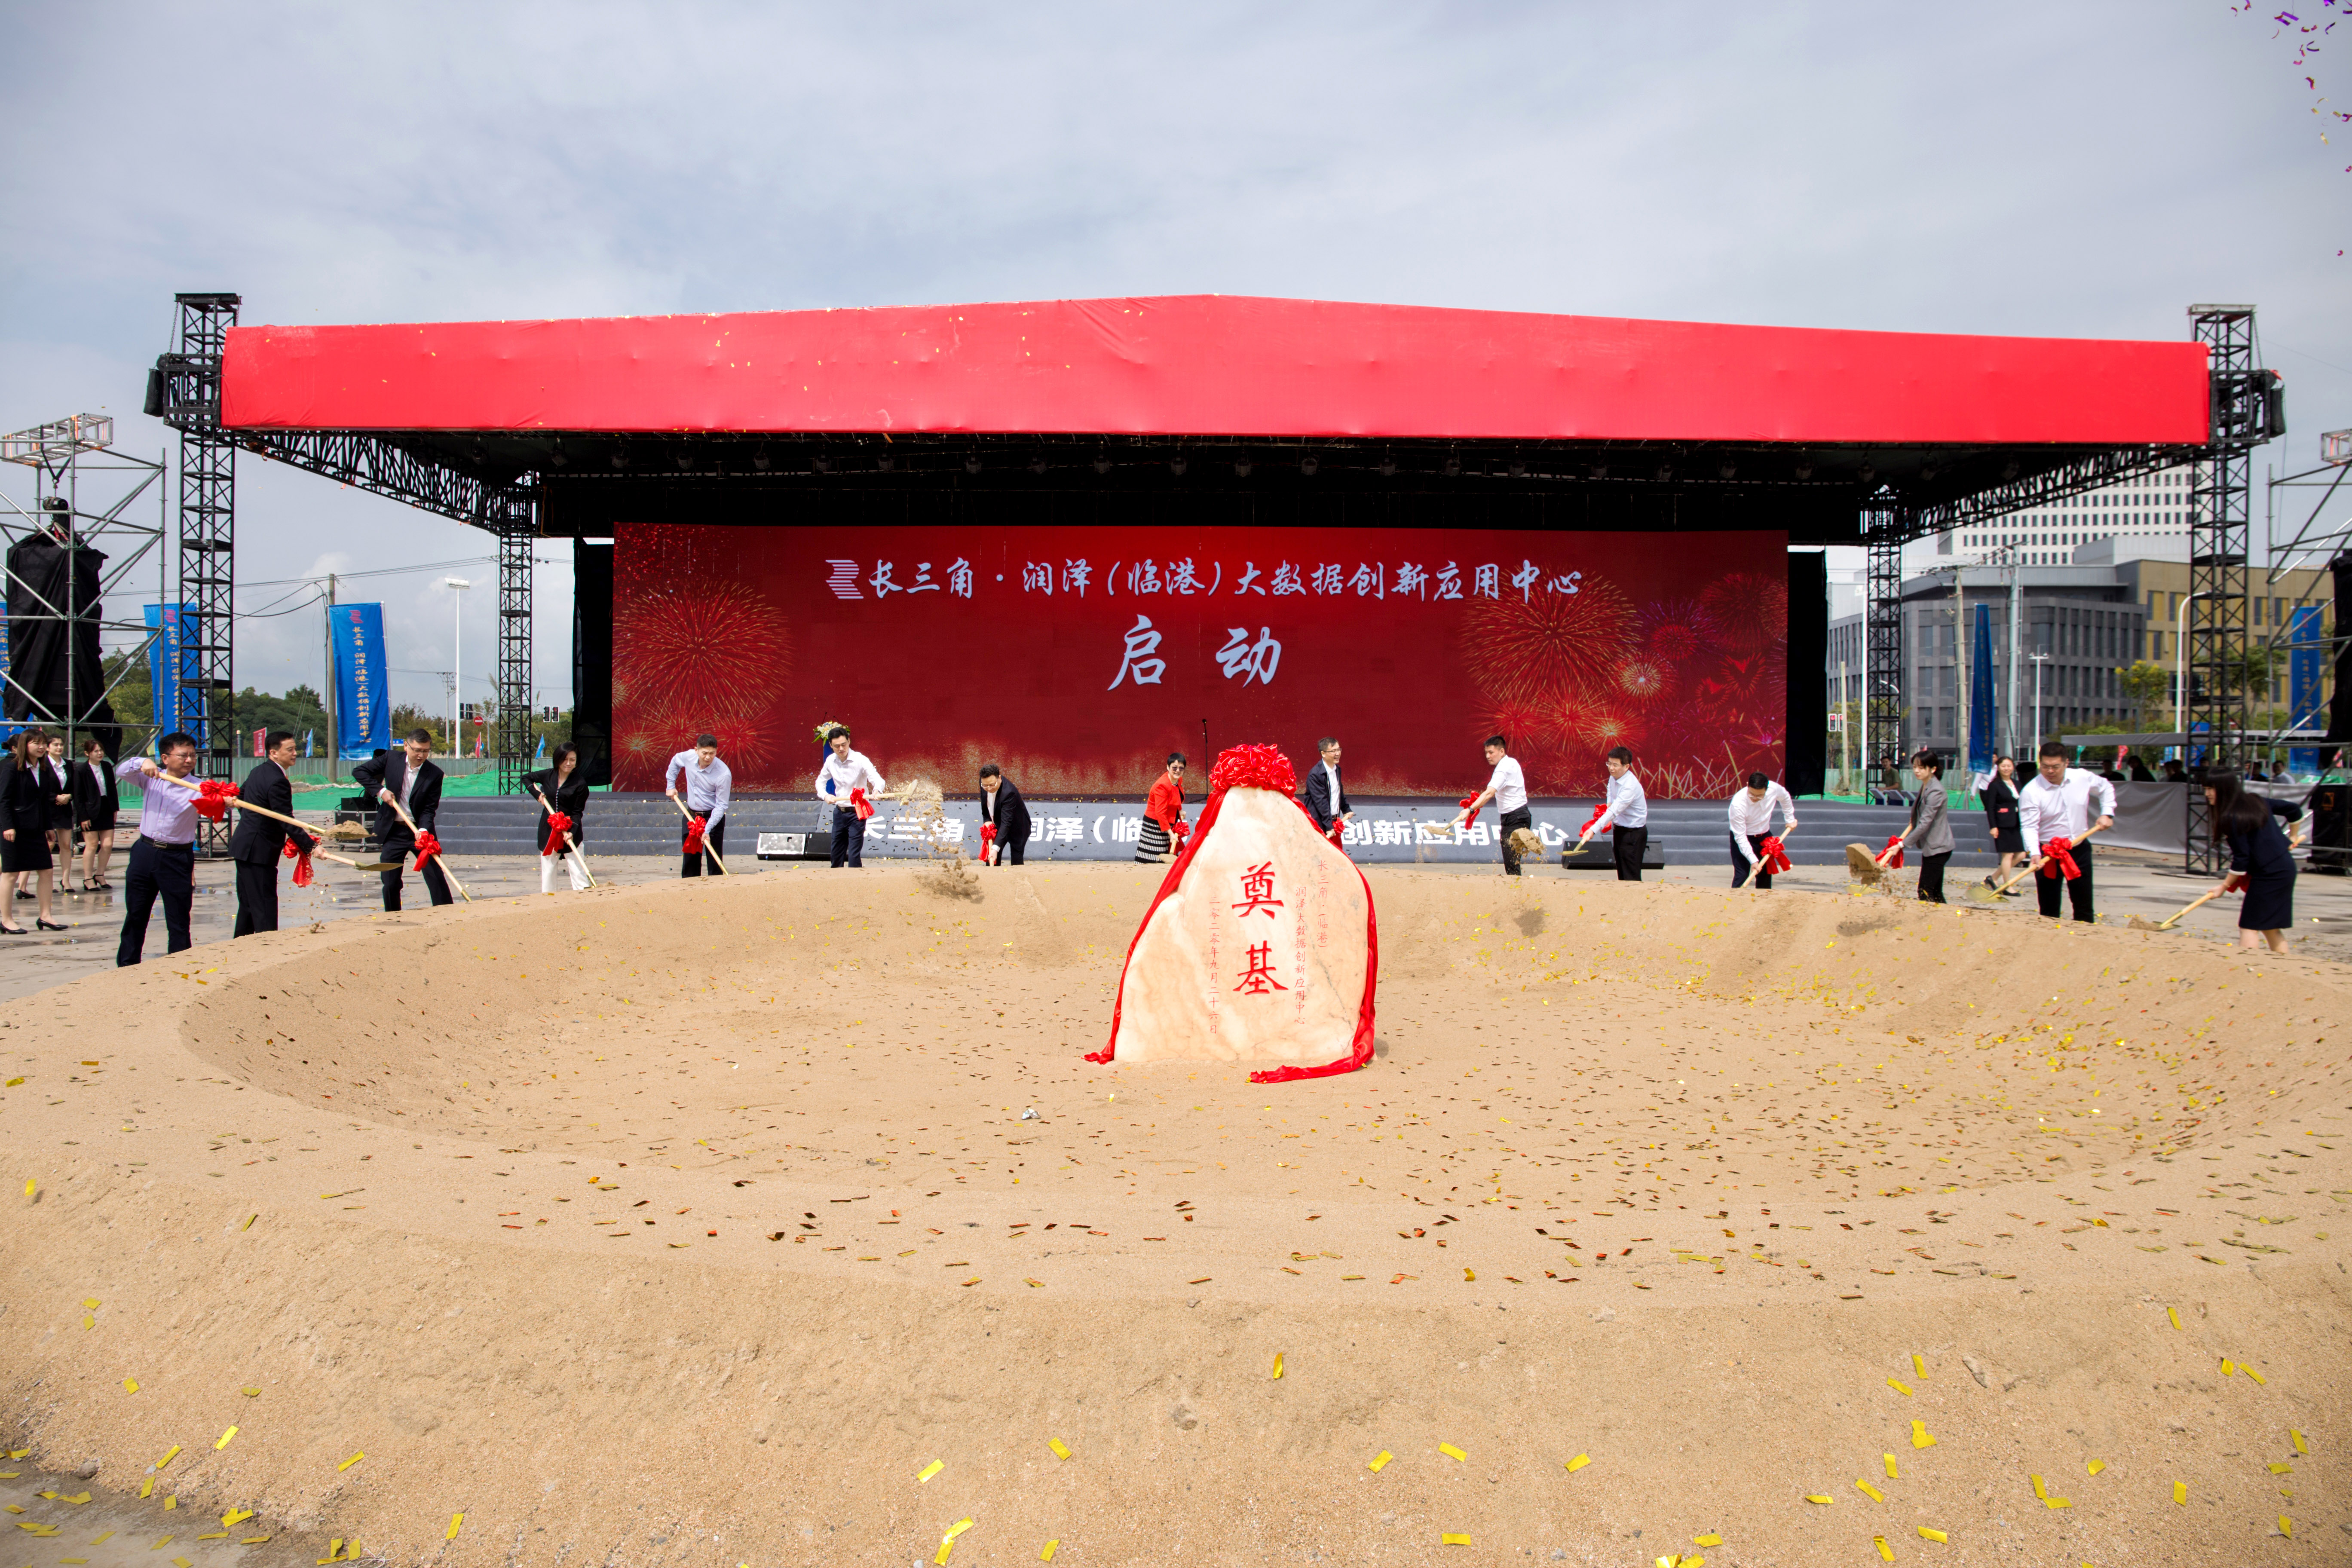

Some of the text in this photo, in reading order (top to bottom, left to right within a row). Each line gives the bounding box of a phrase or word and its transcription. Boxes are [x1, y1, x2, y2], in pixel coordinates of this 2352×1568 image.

[1107, 614, 1282, 691] 启动
[1208, 896, 1221, 1034] 二零二零年九月二十六日
[1231, 861, 1289, 995] 奠基
[1294, 886, 1307, 1025] 润泽大数据创新应用中心
